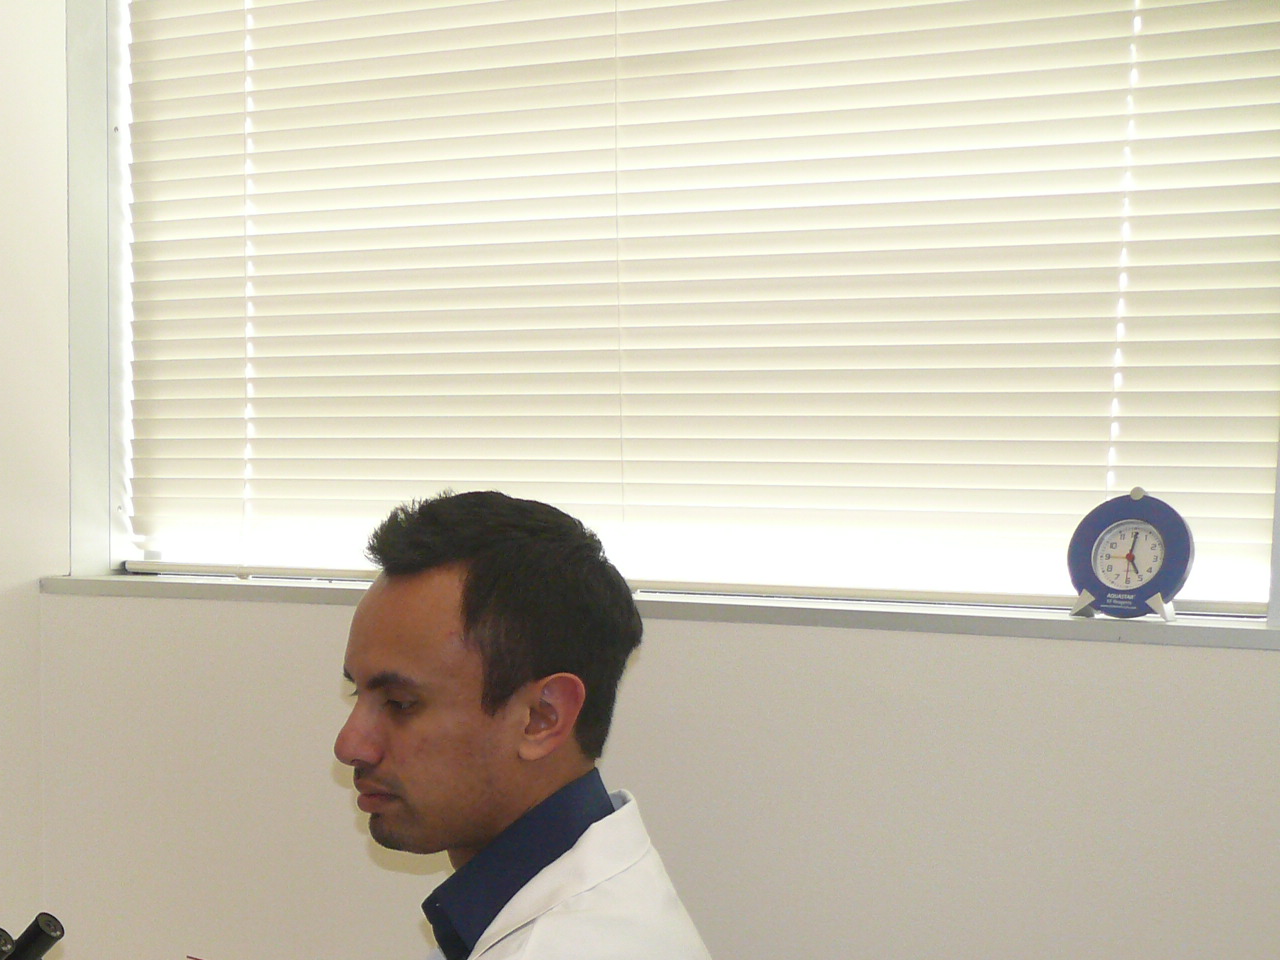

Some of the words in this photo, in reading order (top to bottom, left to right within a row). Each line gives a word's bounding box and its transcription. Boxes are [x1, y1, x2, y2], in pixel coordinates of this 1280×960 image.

[1151, 543, 1158, 551] 2
[1152, 555, 1158, 563] 3
[1107, 564, 1113, 572] 8
[1114, 573, 1120, 581] 7
[1125, 576, 1131, 584] 6
[1137, 574, 1144, 582] 5
